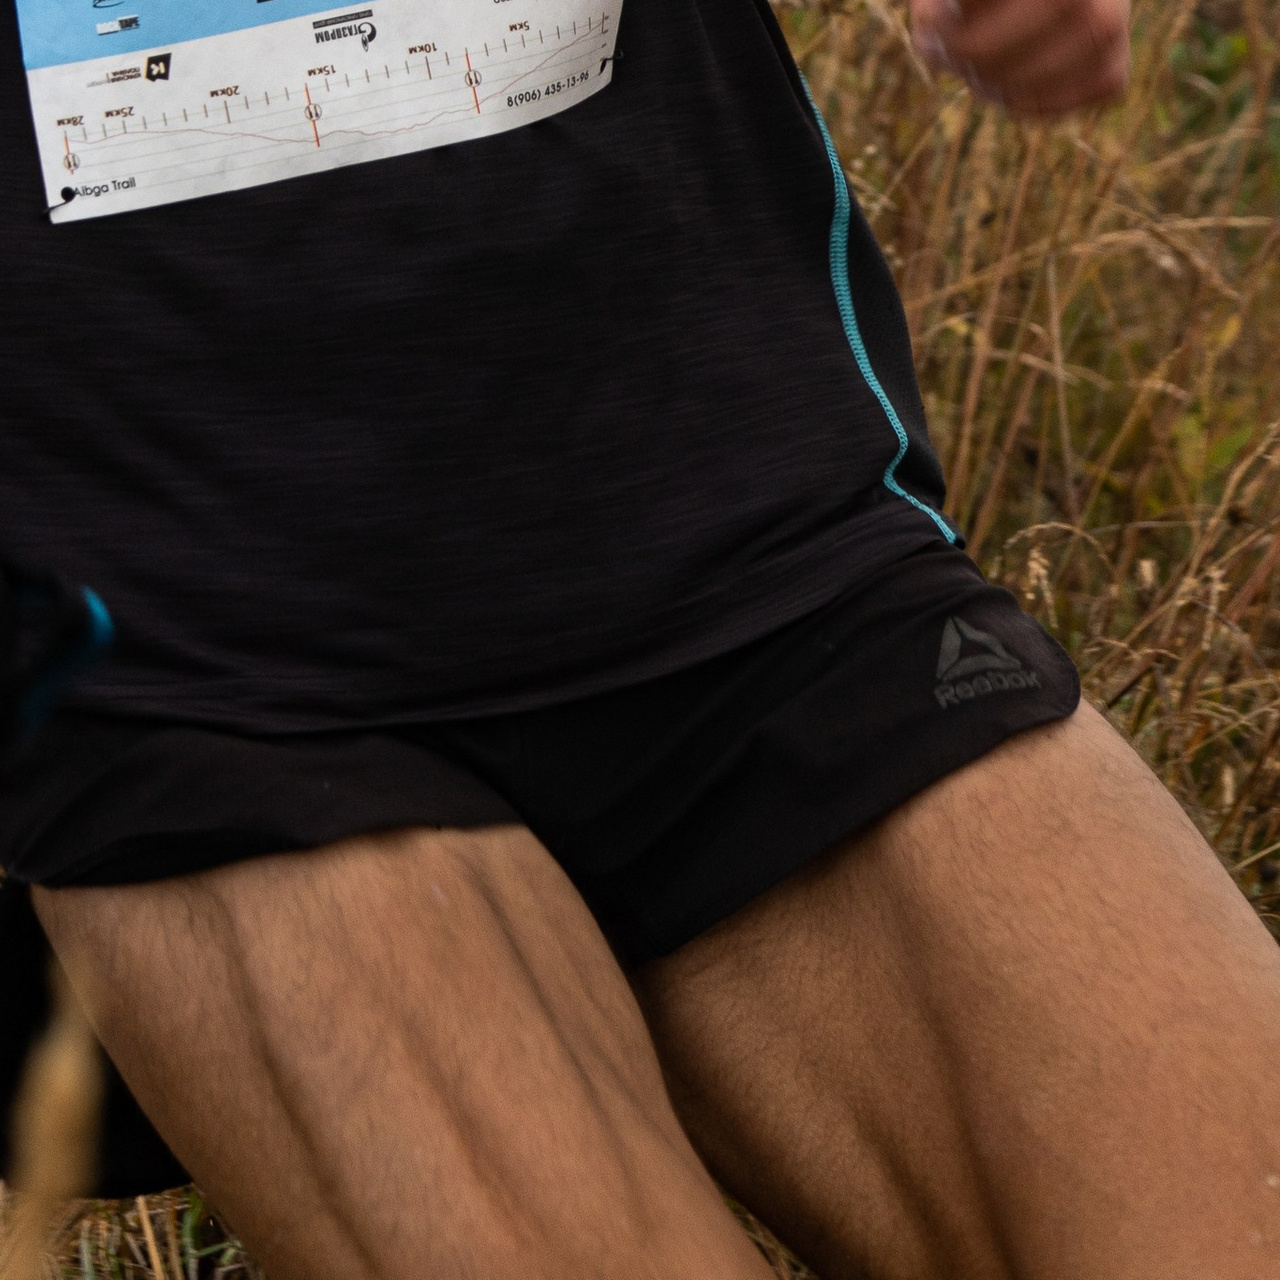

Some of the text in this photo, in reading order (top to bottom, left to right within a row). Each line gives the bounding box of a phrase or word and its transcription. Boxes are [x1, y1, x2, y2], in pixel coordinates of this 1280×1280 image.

[314, 23, 359, 44] ГАЗПРОМ
[507, 70, 590, 107] 8(906) 435-13-96
[111, 177, 136, 191] Trail
